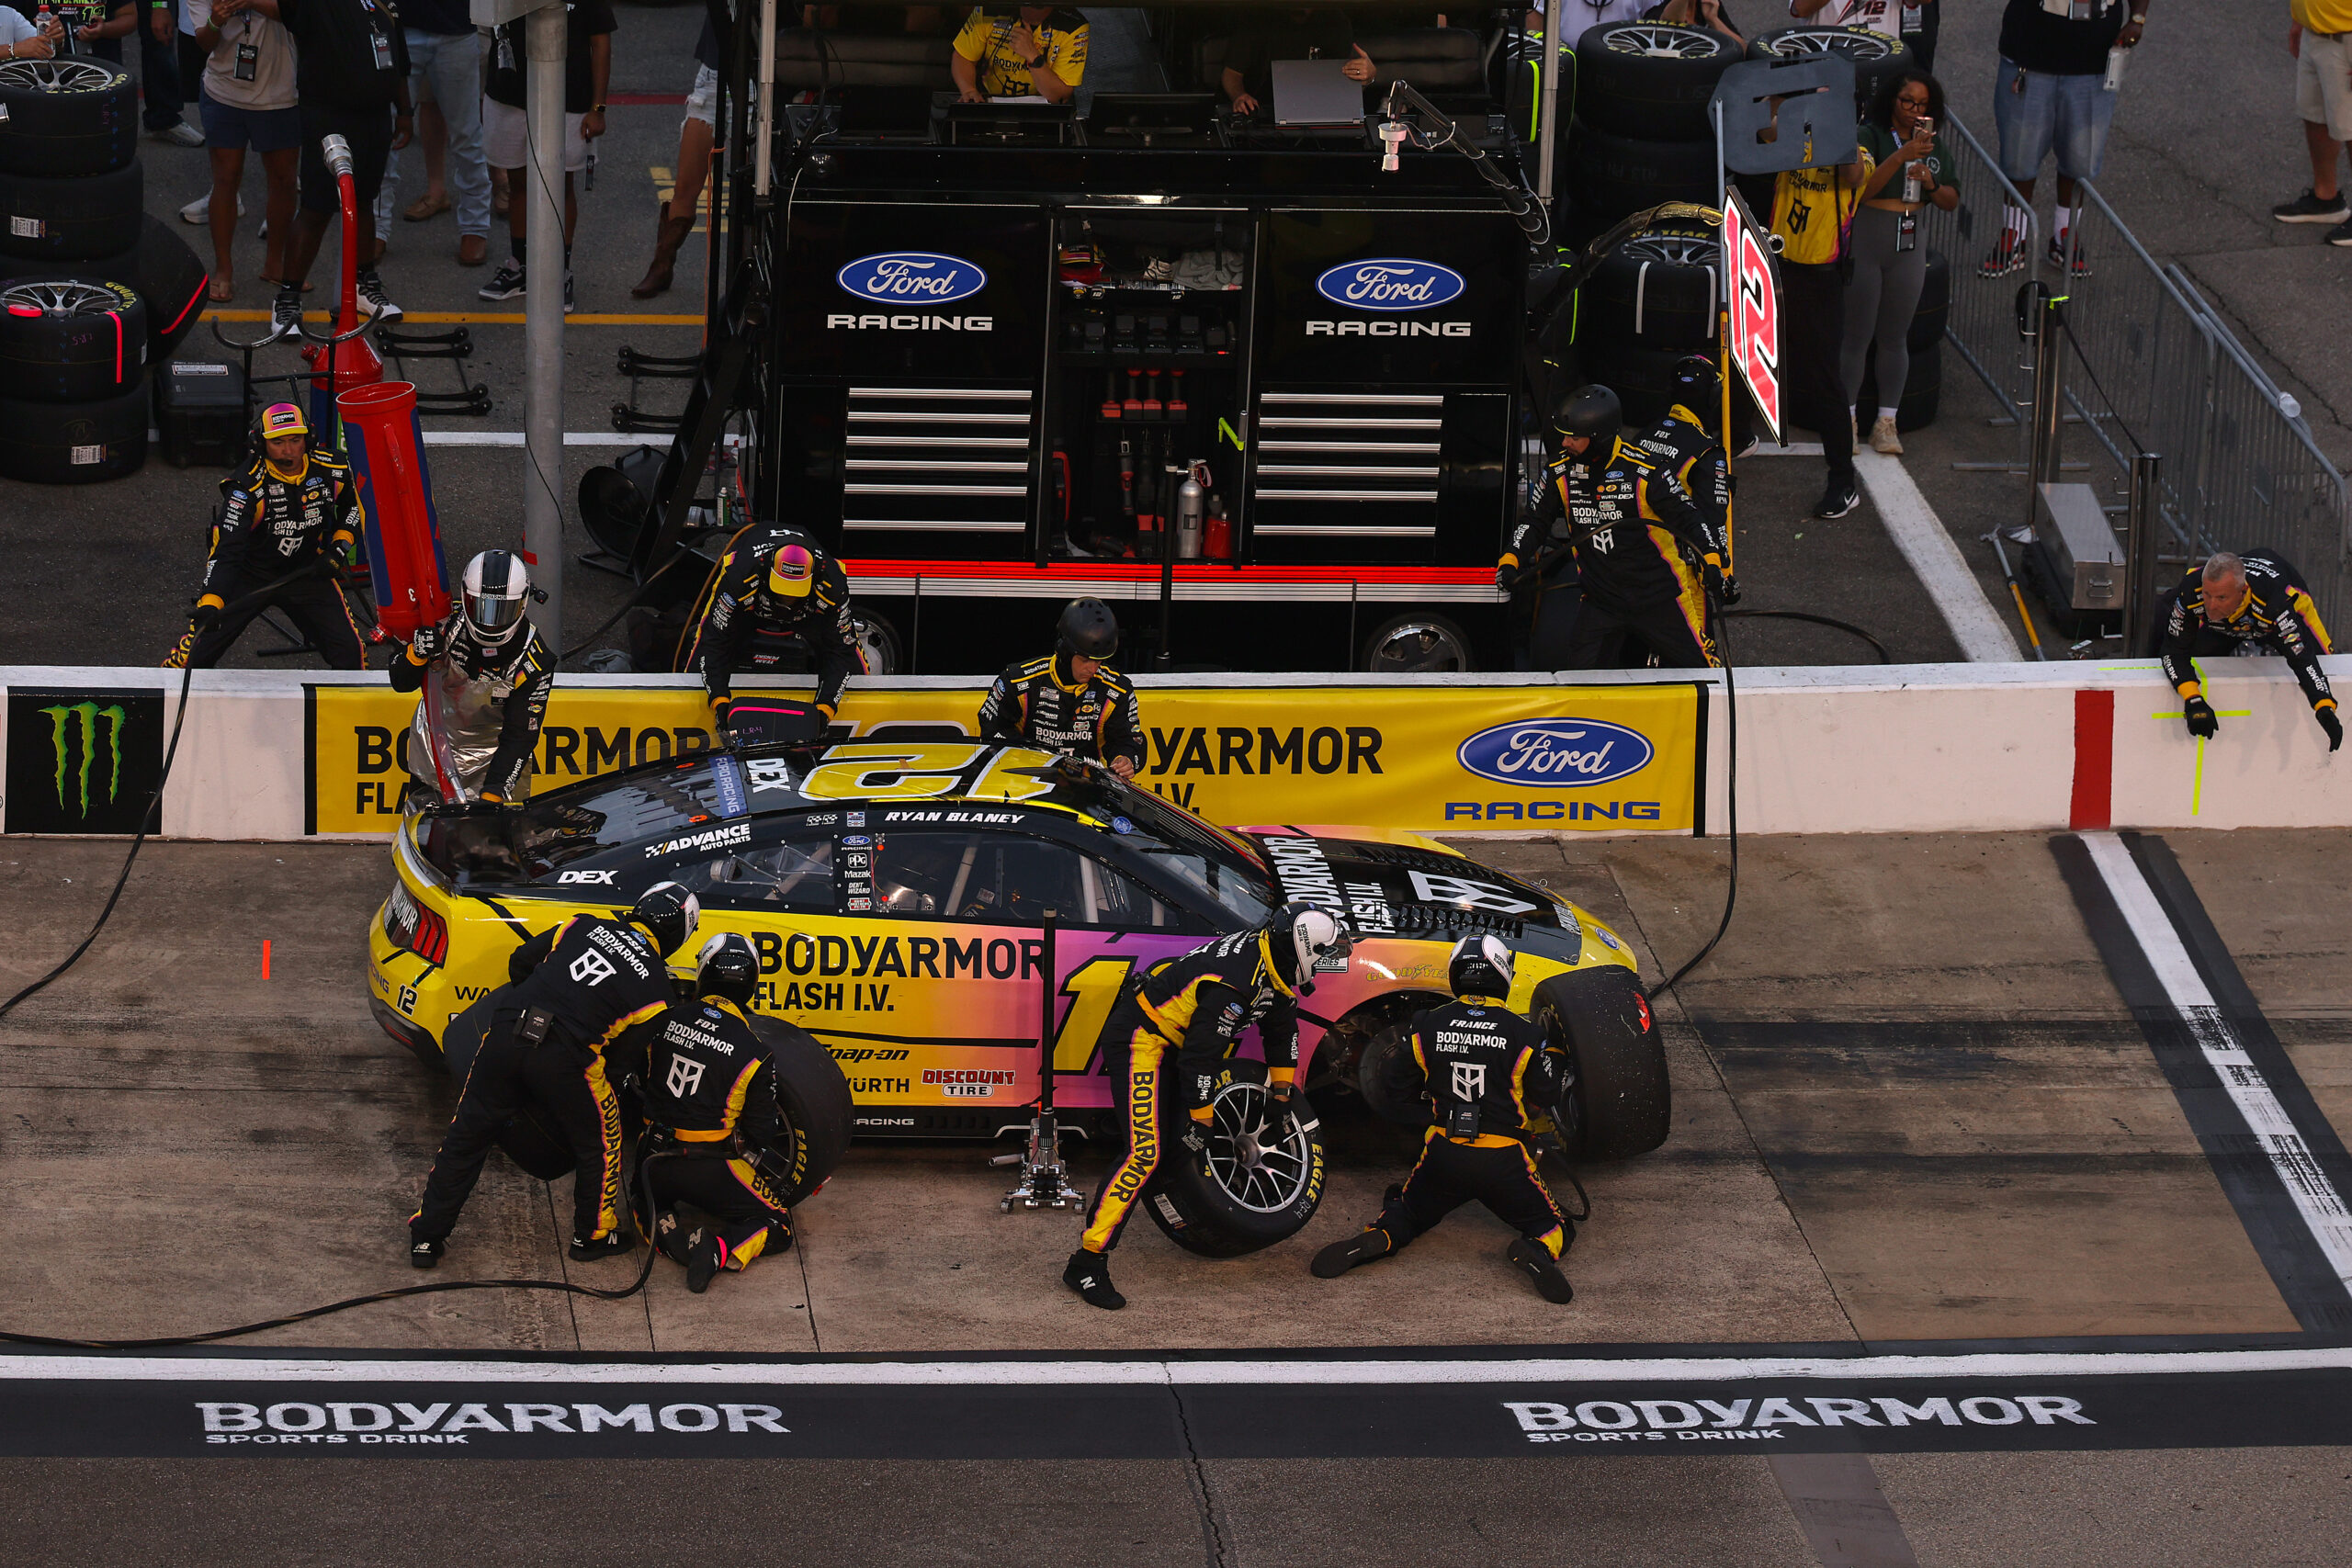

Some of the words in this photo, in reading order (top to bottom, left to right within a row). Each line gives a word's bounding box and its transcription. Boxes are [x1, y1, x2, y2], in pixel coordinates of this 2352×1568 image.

[1863, 1, 1885, 16] 12
[866, 259, 957, 296] Ford
[1345, 265, 1436, 301] Ford
[827, 314, 993, 332] RACING
[1724, 195, 1781, 442] 12
[1306, 321, 1472, 337] RACING
[1655, 430, 1671, 439] FOX
[1497, 728, 1614, 774] Ford
[715, 756, 729, 776] FORD
[746, 757, 792, 794] DEX
[797, 742, 1063, 802] 12
[720, 777, 741, 814] RACING
[885, 811, 943, 822] RYAN
[946, 812, 1025, 825] BLANEY
[1444, 801, 1661, 822] RACING
[664, 823, 751, 853] ADVANCE
[699, 840, 722, 852] AUTO
[723, 835, 752, 848] PARTS
[849, 854, 866, 866] PPG
[557, 870, 619, 885] DEX
[844, 870, 872, 879] Mazak
[585, 931, 607, 951] FLASH
[616, 930, 650, 958] APSEY
[1300, 922, 1313, 957] BODYARMOR
[592, 925, 650, 980] BODYARMOR
[751, 931, 1044, 980] BODYARMOR
[1314, 956, 1340, 966] ERIES
[396, 983, 418, 1016] 12
[753, 982, 843, 1011] FLASH
[854, 984, 895, 1011] I.V.
[694, 1018, 719, 1032] FOX
[1449, 1019, 1498, 1031] FRANCE
[662, 1032, 684, 1047] FLASH
[666, 1020, 735, 1056] BODYARMOR
[1436, 1031, 1508, 1050] BODYARMOR
[1435, 1043, 1458, 1054] FLASH
[922, 1068, 1016, 1086] DISCOUNT
[947, 1086, 989, 1097] TIRE
[853, 1118, 915, 1126] ACING
[1108, 1069, 1154, 1203] BODYARMOR
[600, 1090, 622, 1212] BODYARMOR
[791, 1126, 808, 1187] EAGLE
[1306, 1142, 1324, 1203] EAGLE
[1079, 1276, 1096, 1290] N
[194, 1401, 792, 1434] BODYARMOR
[1501, 1395, 2098, 1433] BODYARMOR
[205, 1433, 349, 1445] SPORTS
[358, 1434, 470, 1446] DRINK
[1526, 1431, 1668, 1444] SPORTS
[1677, 1428, 1786, 1442] DRINK
